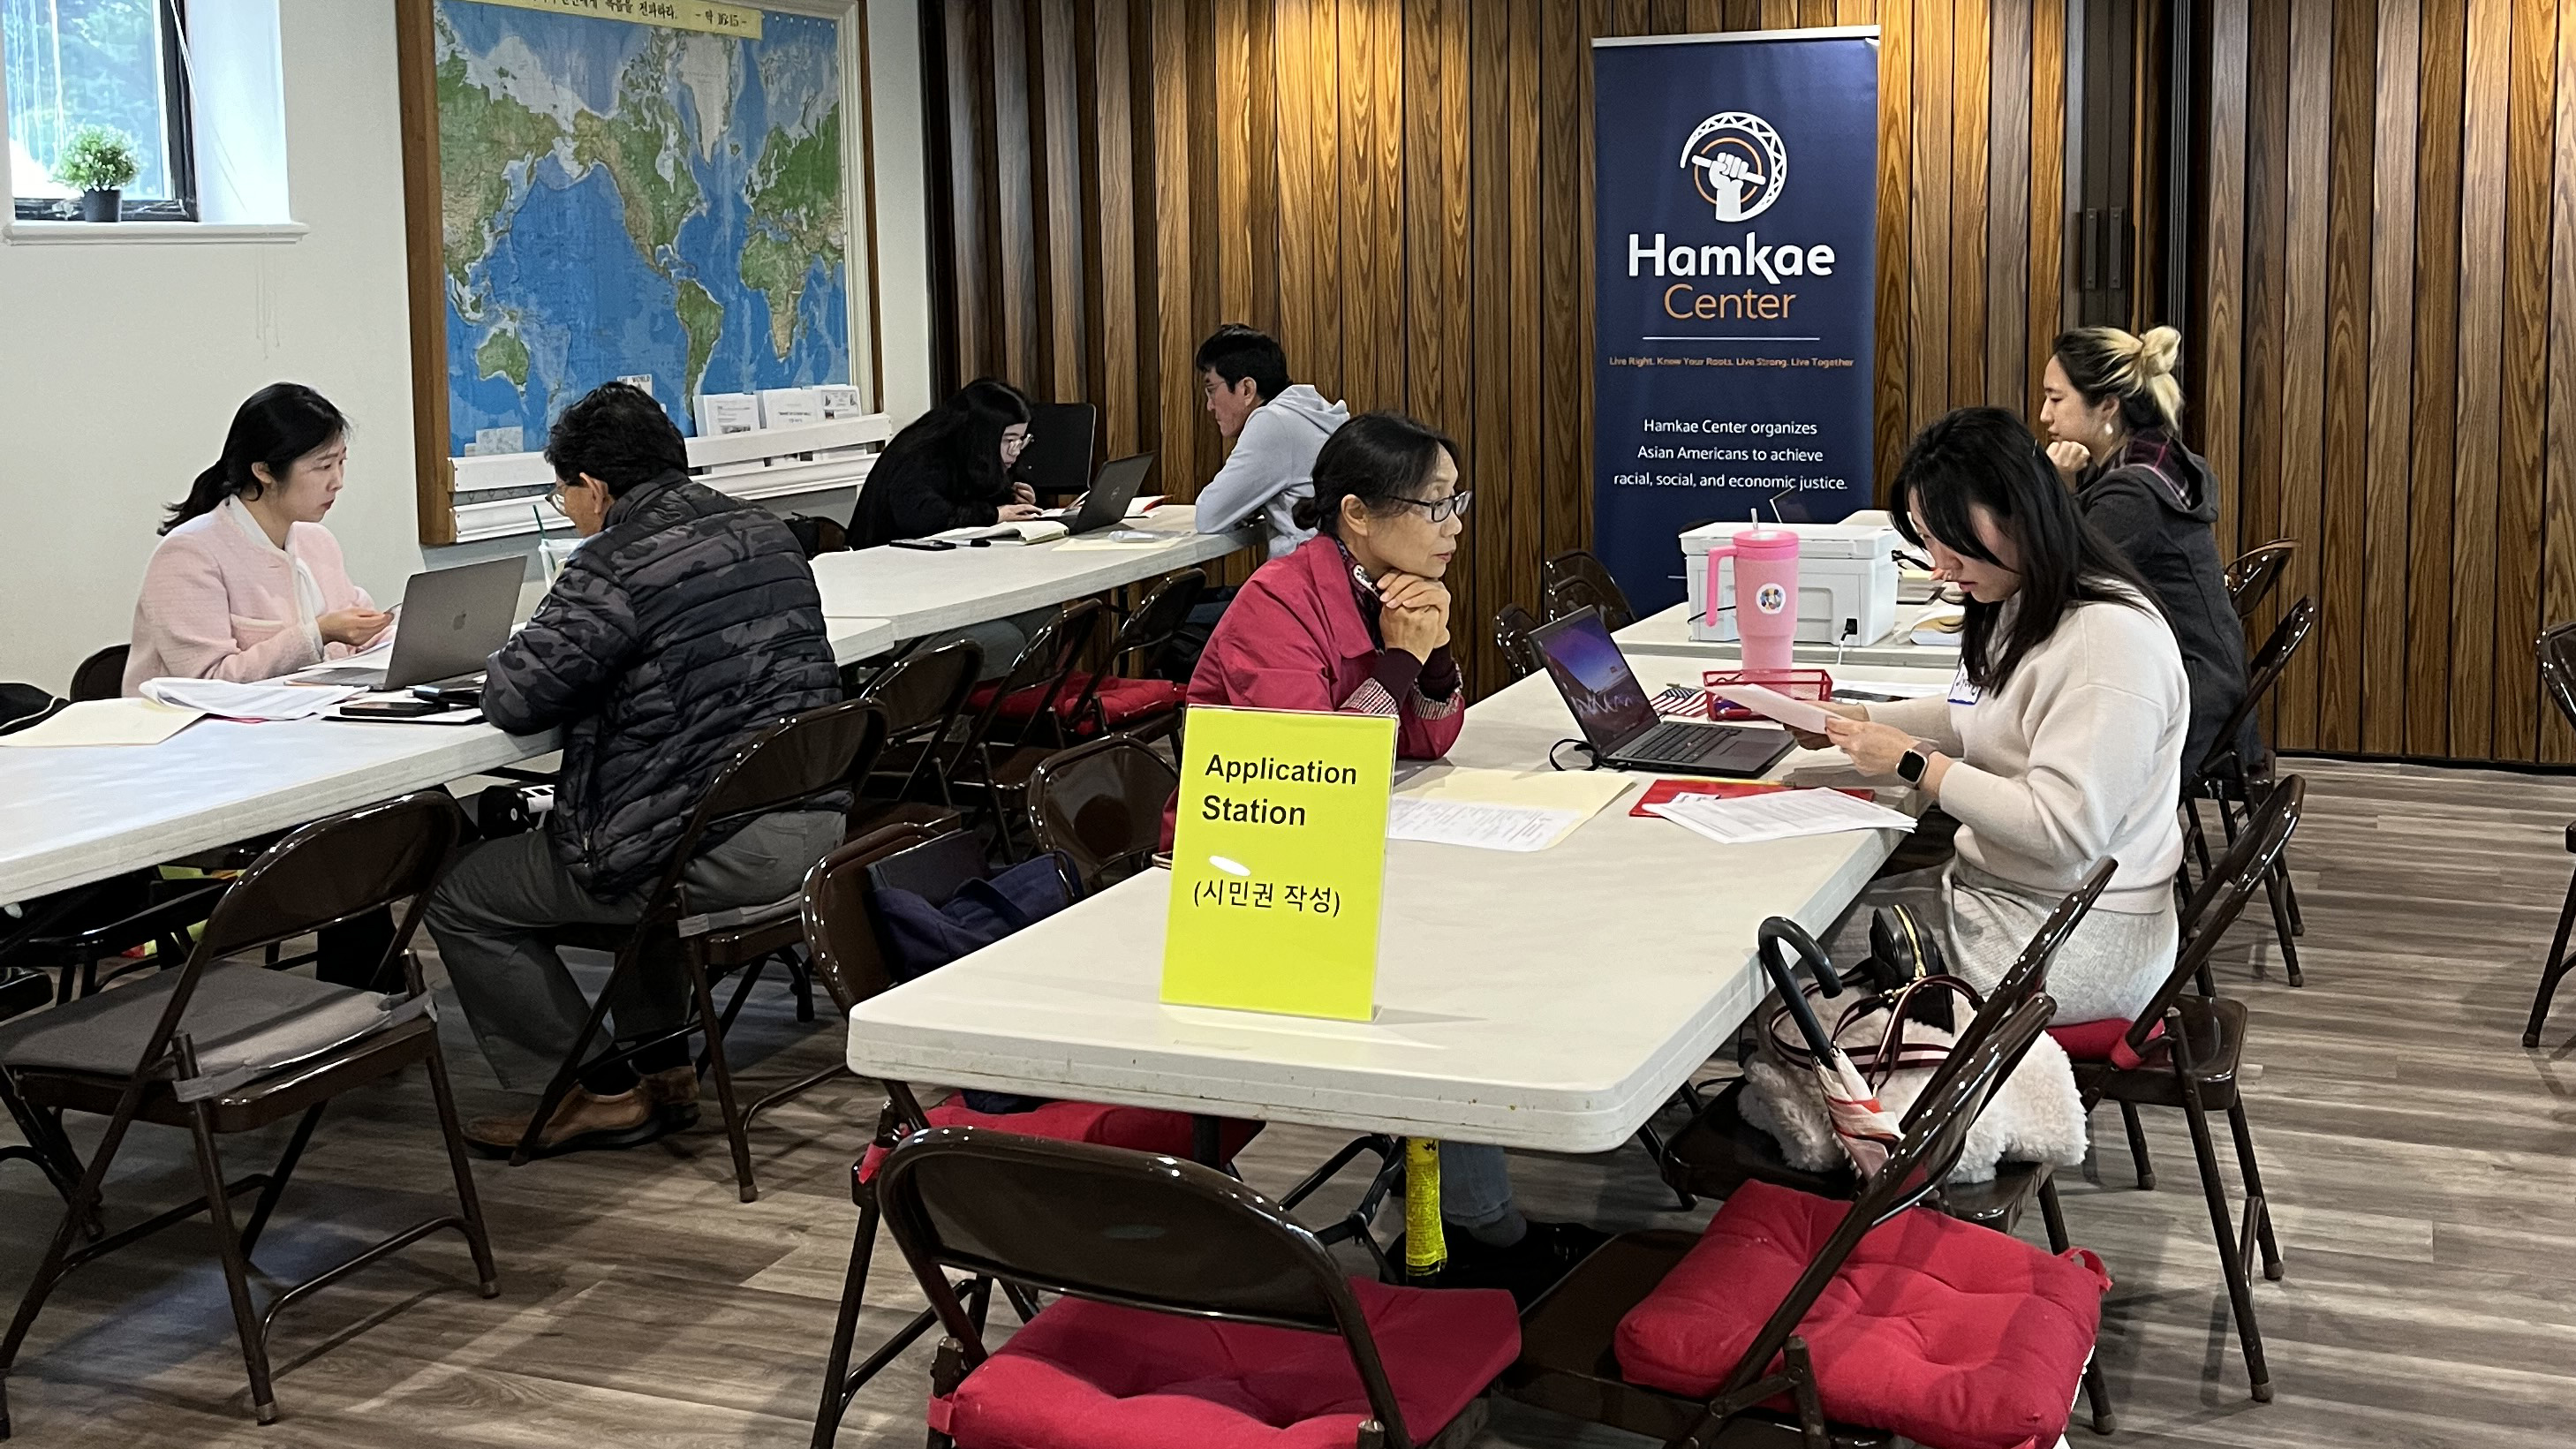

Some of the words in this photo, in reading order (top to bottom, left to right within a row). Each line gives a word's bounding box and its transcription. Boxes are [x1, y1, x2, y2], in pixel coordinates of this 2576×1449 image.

[1628, 231, 1835, 284] Hamkae
[1664, 283, 1797, 320] Center
[1609, 357, 1627, 366] Live
[1628, 357, 1654, 367] Right.
[1657, 357, 1682, 366] Know
[1683, 357, 1704, 366] Your
[1736, 357, 1755, 366] Live
[1791, 357, 1809, 366] Live
[1810, 358, 1855, 369] Together
[1643, 419, 1699, 434] Hamkae
[1702, 419, 1748, 434] Center
[1750, 420, 1817, 437] organizes
[1637, 445, 1674, 459] Asian
[1677, 446, 1749, 461] Americans
[1752, 449, 1767, 461] to
[1770, 448, 1824, 462] achieve
[1613, 472, 1653, 487] racial,
[1656, 472, 1697, 487] social,
[1700, 473, 1726, 487] and
[1728, 474, 1796, 489] economic
[1799, 475, 1848, 491] justice.
[1205, 753, 1357, 785] Application
[1202, 795, 1306, 826] Station
[1193, 879, 1274, 909] (시민권
[1284, 885, 1341, 917] 작성)
